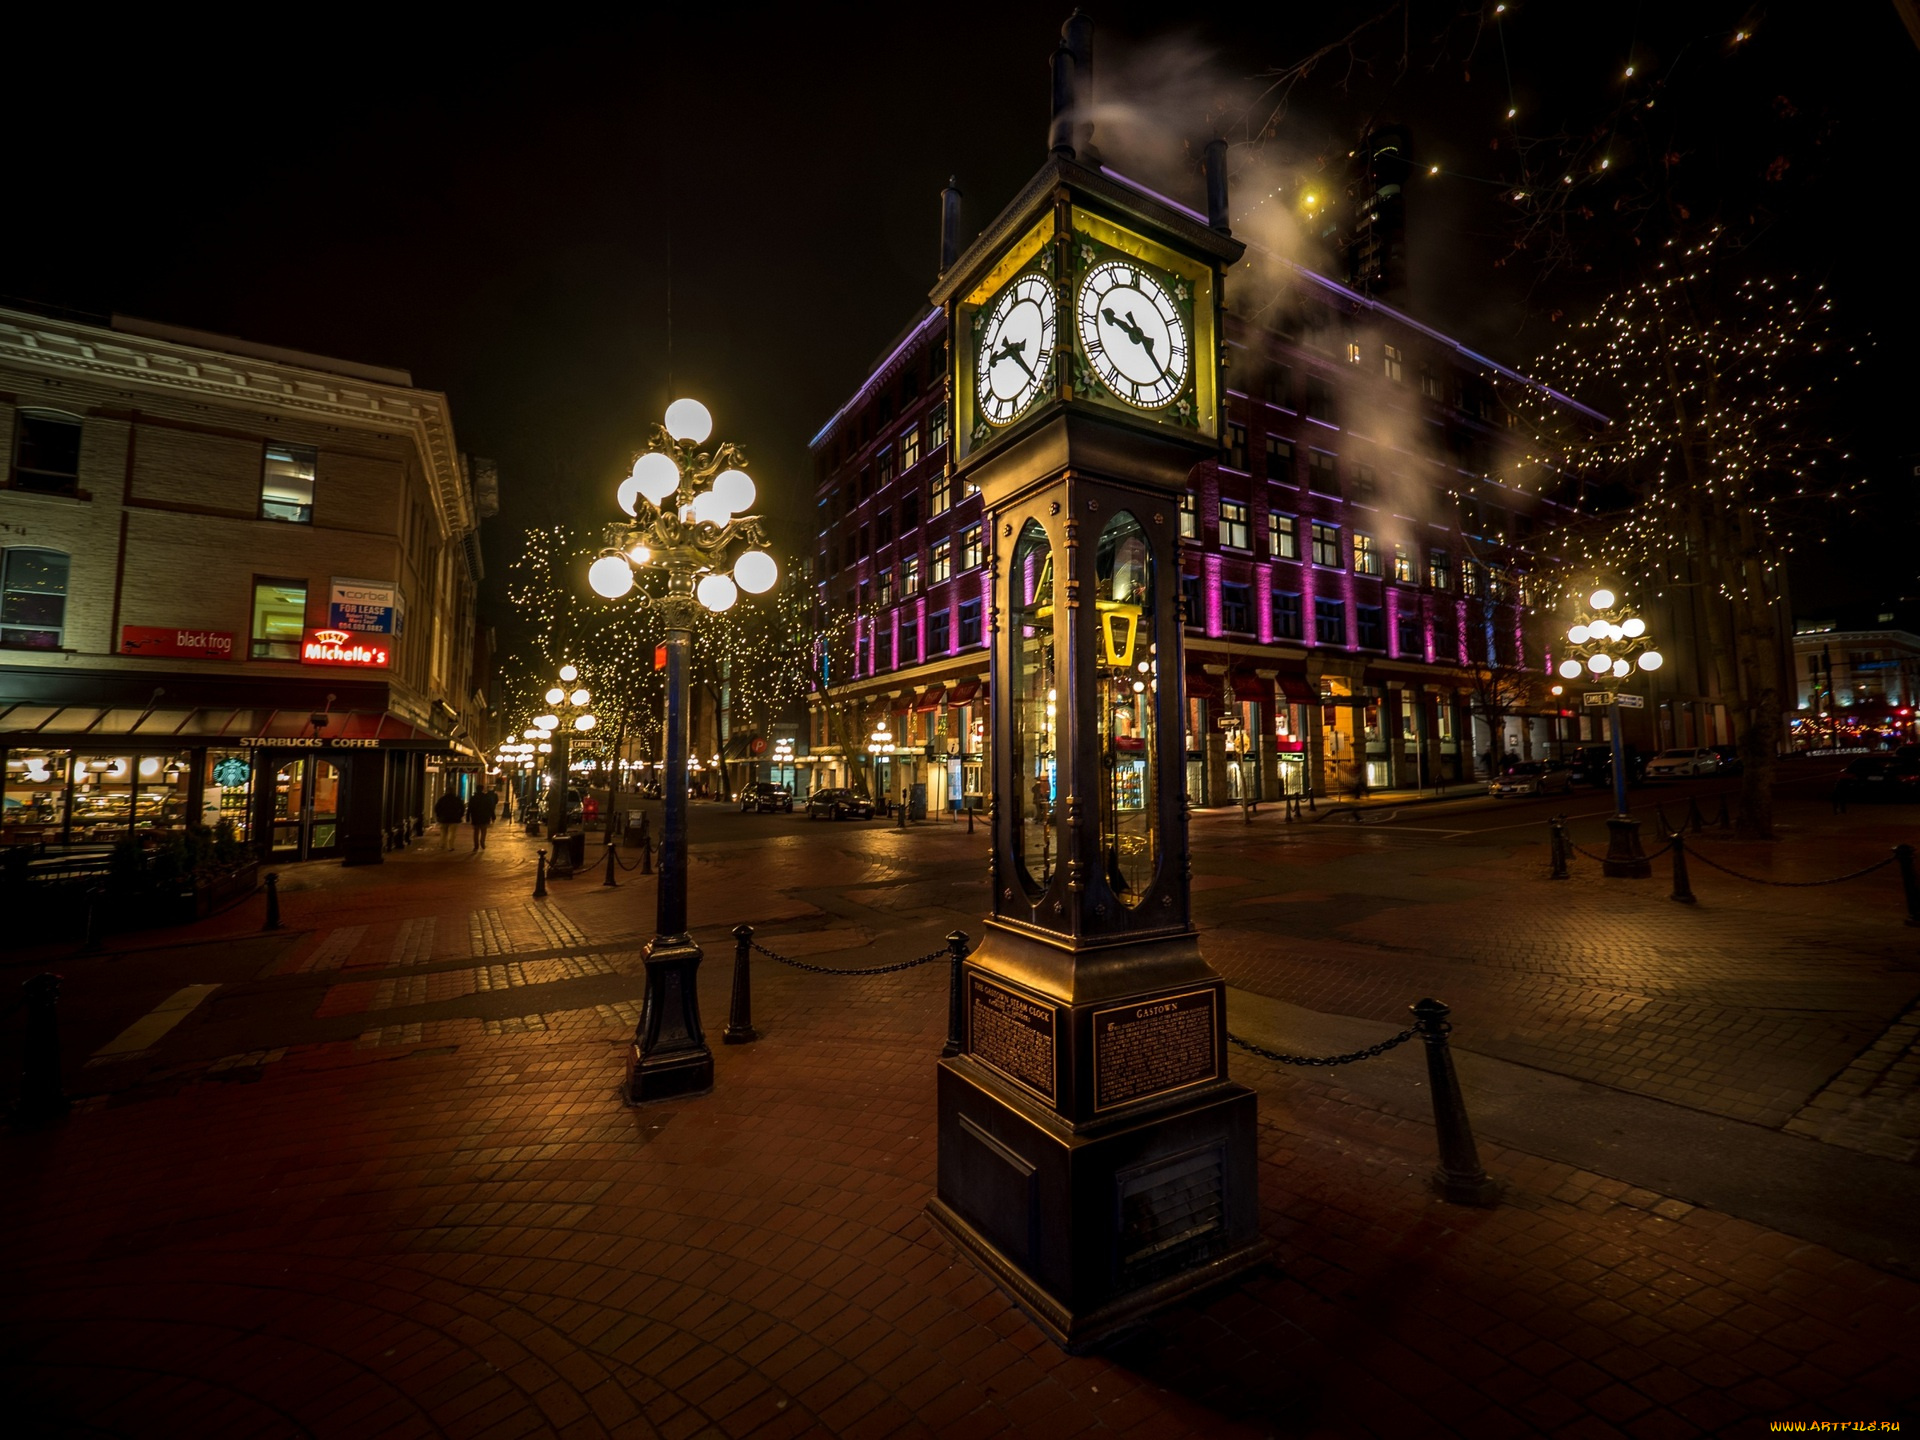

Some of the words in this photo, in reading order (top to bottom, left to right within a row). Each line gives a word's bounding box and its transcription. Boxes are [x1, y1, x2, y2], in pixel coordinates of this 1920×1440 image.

[346, 591, 388, 601] corbel
[340, 603, 357, 613] FOR
[359, 605, 385, 615] LEASE
[176, 630, 208, 648] black
[208, 632, 232, 652] frog
[316, 633, 345, 643] VISIT
[304, 644, 386, 663] Michelle's
[239, 737, 323, 748] STARBUCKS
[330, 738, 380, 748] COFFEE
[984, 986, 1009, 1003] GASTOWN
[1010, 996, 1028, 1012] STEAM
[1028, 1006, 1050, 1022] CLOCK
[1136, 1003, 1178, 1018] GASTOWN
